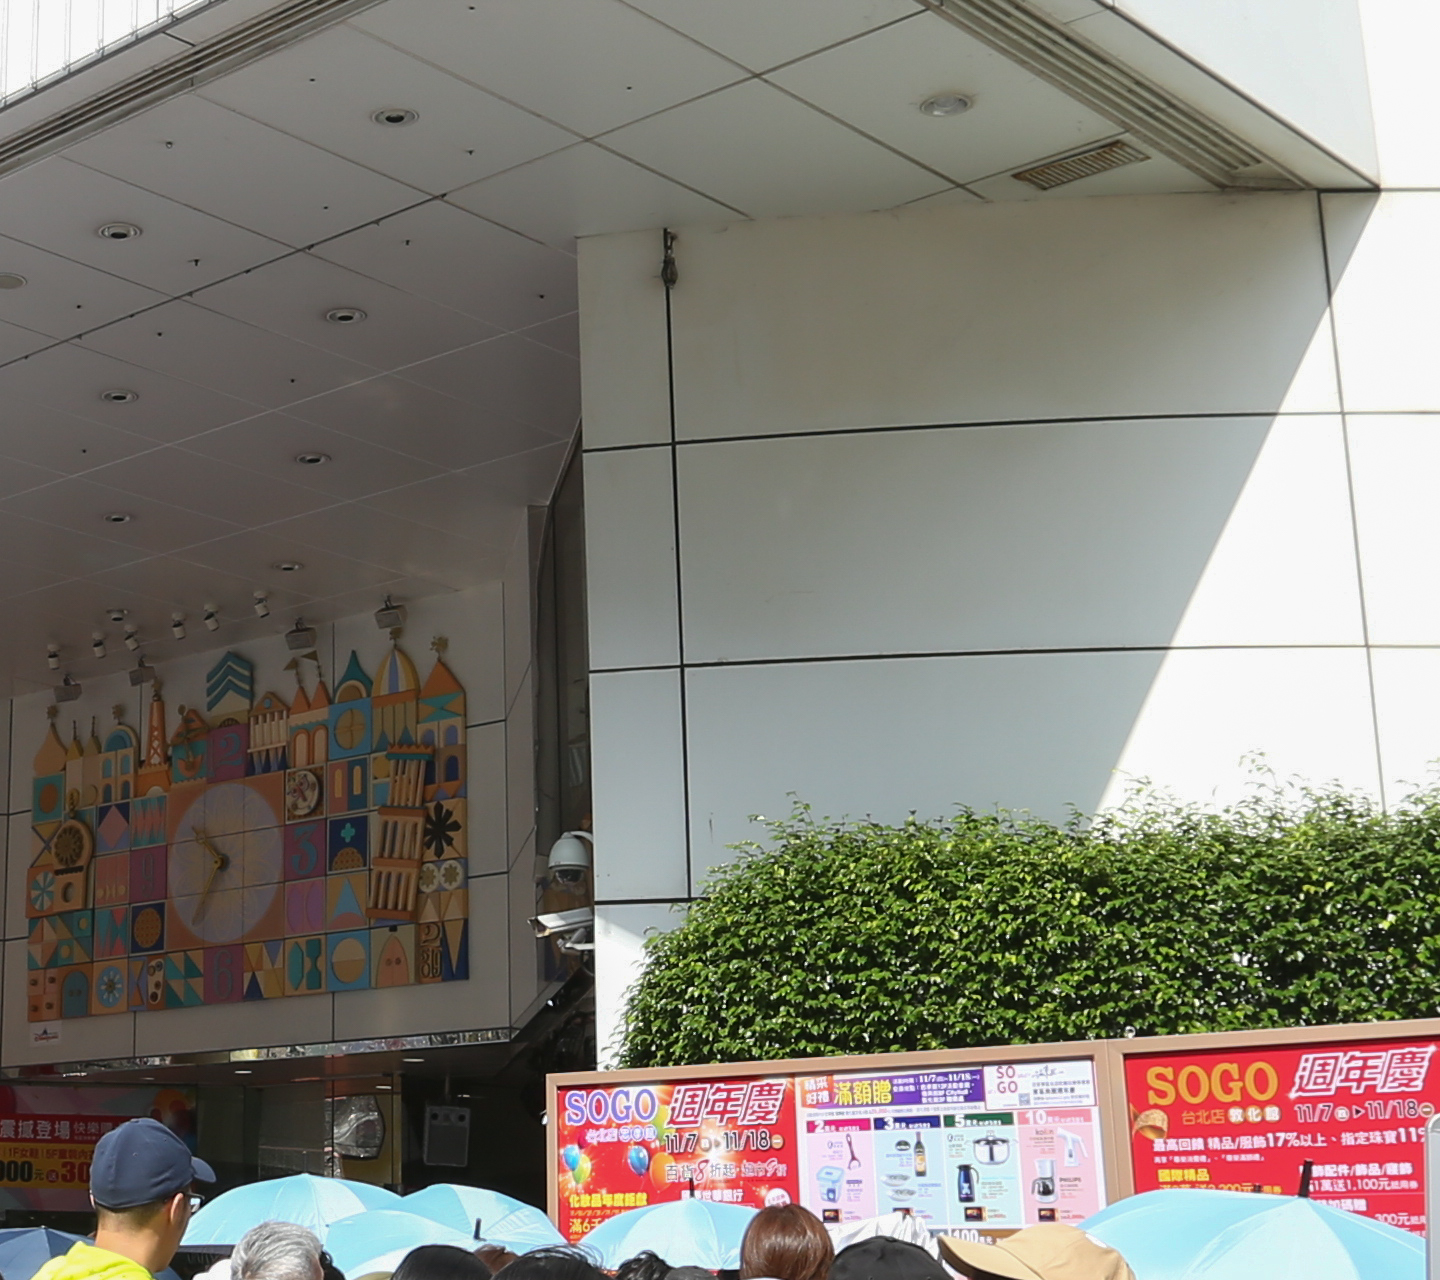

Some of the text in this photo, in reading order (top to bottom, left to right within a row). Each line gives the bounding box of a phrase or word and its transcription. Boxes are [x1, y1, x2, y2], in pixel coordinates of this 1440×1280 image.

[997, 1081, 1018, 1094] GO
[1147, 1061, 1278, 1106] SOGO
[1291, 1047, 1433, 1097] 週年慶
[566, 1081, 787, 1128] SOGO 週年慶
[834, 1079, 893, 1106] 滿額贈
[1182, 1109, 1225, 1125] 台北店
[1295, 1100, 1418, 1122] 11/7 11/18
[665, 1129, 770, 1153] 11/7 11/18
